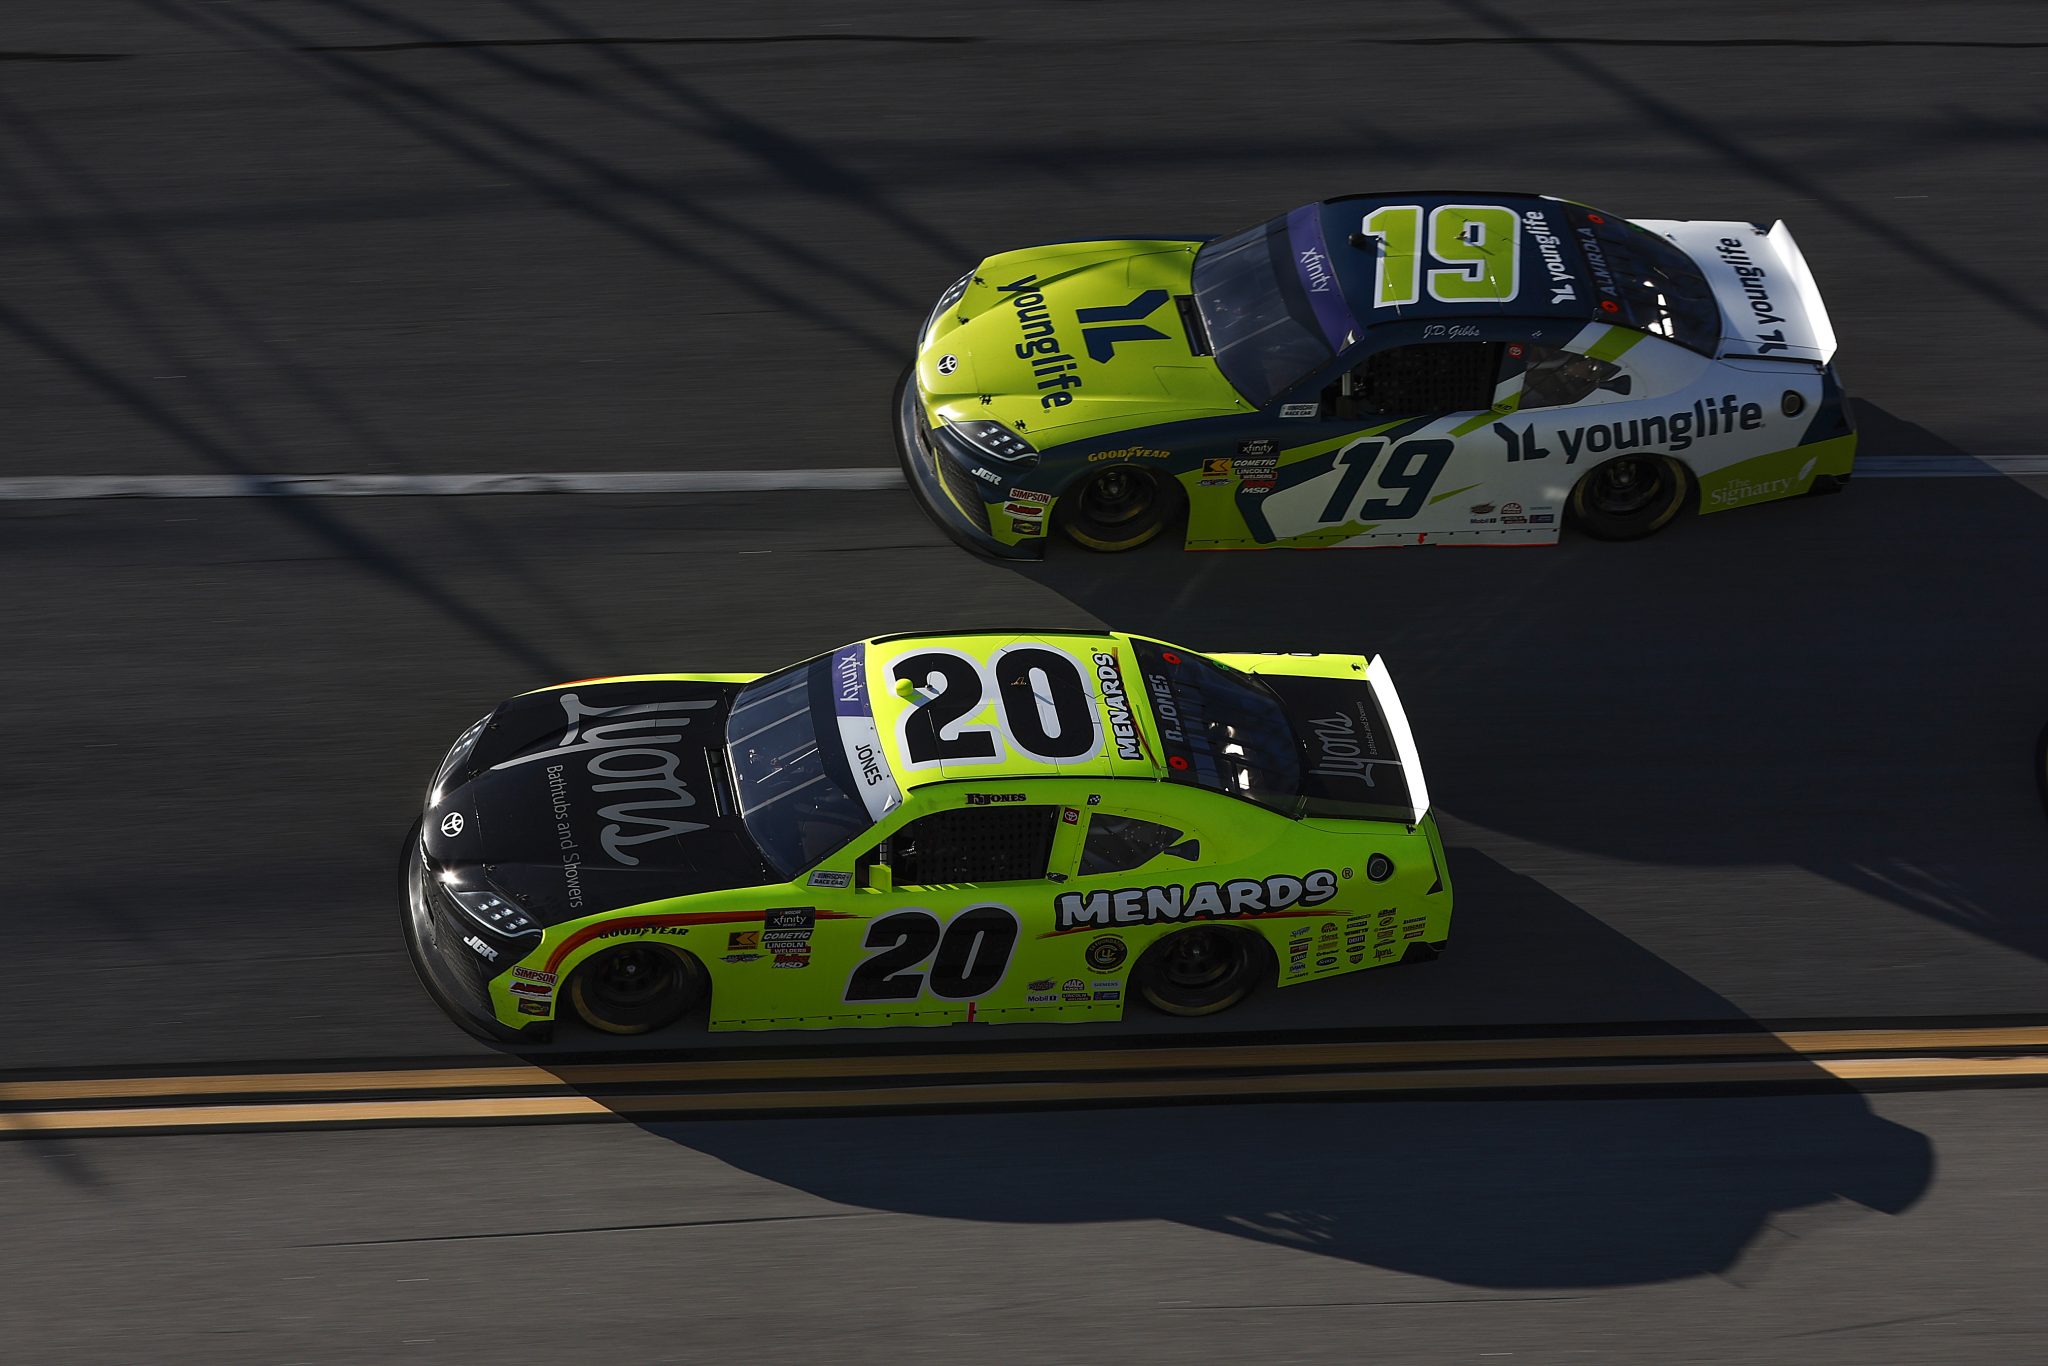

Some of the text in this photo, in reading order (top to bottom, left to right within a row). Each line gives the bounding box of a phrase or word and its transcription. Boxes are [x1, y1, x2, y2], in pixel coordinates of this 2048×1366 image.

[1300, 248, 1331, 294] xfinity
[1362, 205, 1521, 307] 19
[1524, 211, 1575, 281] younglife
[1576, 228, 1617, 296] ALMIROLA
[1716, 238, 1785, 324] younglife
[997, 274, 1082, 409] younglife
[1423, 325, 1480, 339] J.D. Gibbs
[1088, 447, 1170, 462] GOODYEAR
[1243, 443, 1273, 453] xfinity
[1557, 394, 1763, 464] younglife
[971, 467, 1002, 485] JGR
[1011, 489, 1050, 503] SIMPSON
[1318, 437, 1455, 526] 19
[1711, 478, 1791, 505] Signatry
[838, 653, 864, 701] xfinity
[891, 648, 1096, 765] 20
[1093, 653, 1144, 762] MENARDS
[490, 693, 718, 866] Lyons
[855, 744, 882, 786] JONES
[1308, 711, 1402, 787] Lyons
[546, 764, 583, 908] Bathtubs and Showers
[773, 914, 807, 925] xfinity
[1056, 869, 1338, 931] MENARDS
[463, 935, 499, 962] JGR
[763, 931, 811, 940] COMETIC
[846, 905, 1019, 1002] 20
[514, 968, 556, 984] SIMPSON
